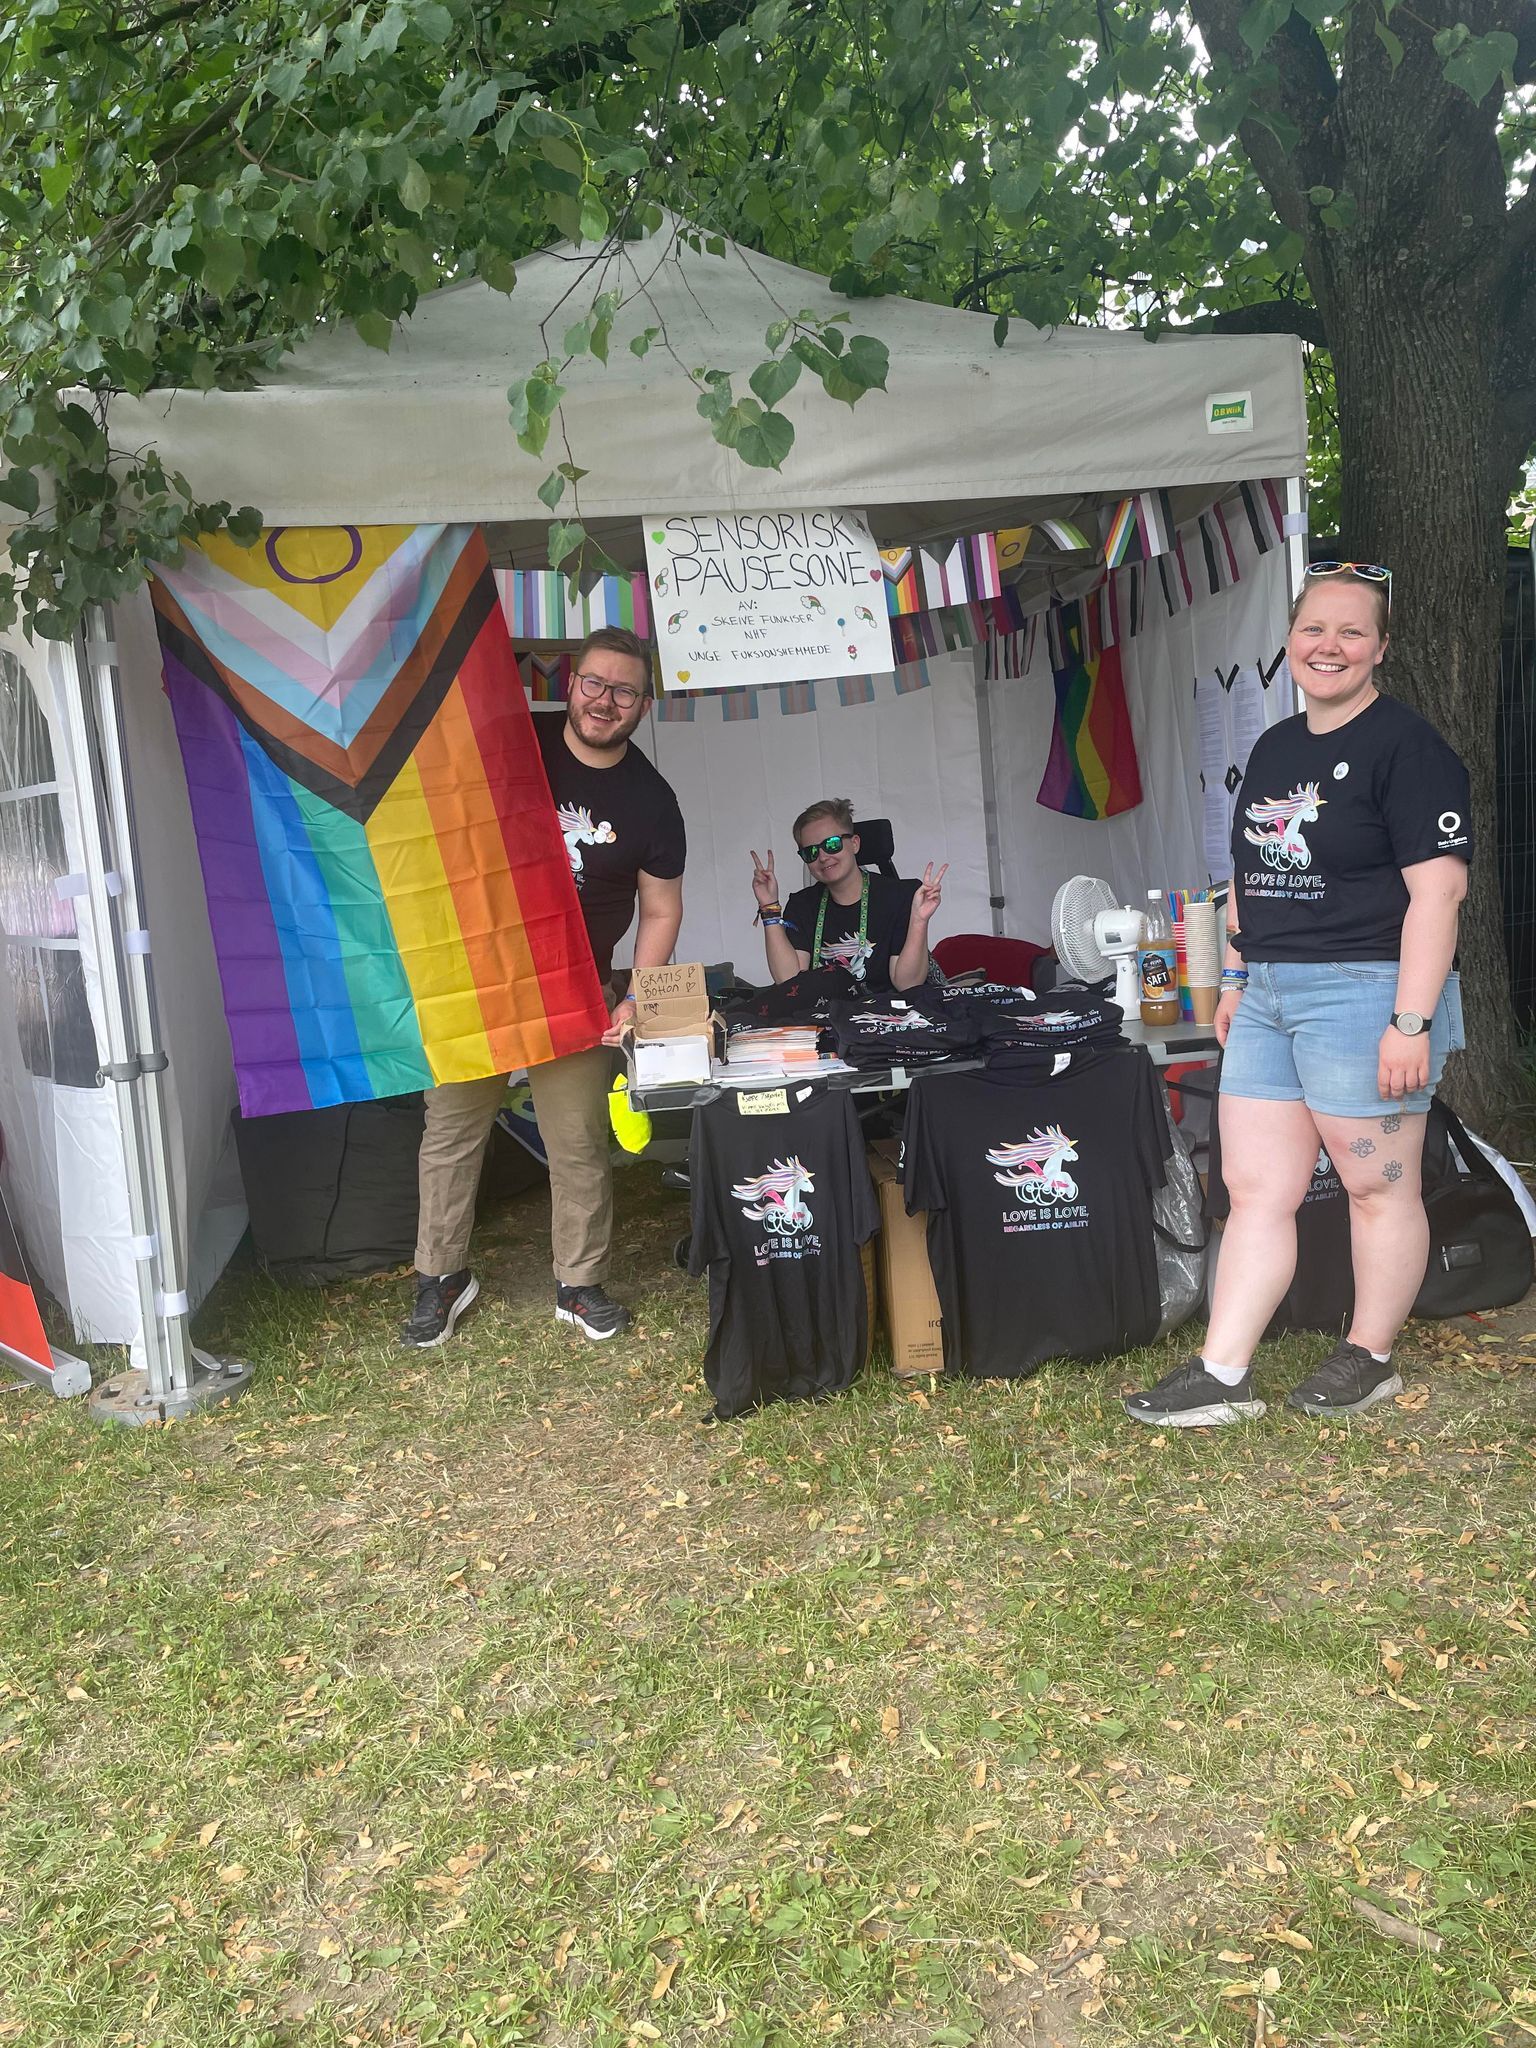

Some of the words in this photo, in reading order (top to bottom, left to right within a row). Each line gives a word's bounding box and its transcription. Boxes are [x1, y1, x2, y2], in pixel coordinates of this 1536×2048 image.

[665, 512, 855, 556] SENSORISK
[671, 552, 869, 597] PAUSESONE
[738, 599, 758, 611] AV:
[711, 615, 756, 626] SKEIVE
[760, 613, 814, 625] FUNKISER
[744, 628, 768, 640] NHF
[688, 650, 722, 661] UNGE
[1244, 872, 1275, 886] LOVE
[1276, 873, 1287, 887] IS
[1288, 874, 1326, 888] LOVE,
[1294, 890, 1326, 900] ABILITY
[640, 968, 682, 989] GRATIS
[1146, 971, 1167, 986] SAFT
[942, 987, 974, 997] LOVE
[1078, 1015, 1103, 1029] ABILITY
[1308, 1177, 1340, 1192] LOVE,
[1315, 1190, 1339, 1201] ABILITY
[1002, 1209, 1037, 1223] LOVE
[1039, 1207, 1052, 1220] IS
[1054, 1205, 1090, 1219] LOVE,
[1003, 1222, 1051, 1233] REGARDLESS
[1051, 1221, 1063, 1230] OF
[1063, 1220, 1089, 1229] ABILITY
[781, 1237, 793, 1249] IS
[756, 1251, 792, 1267] REGDLESS
